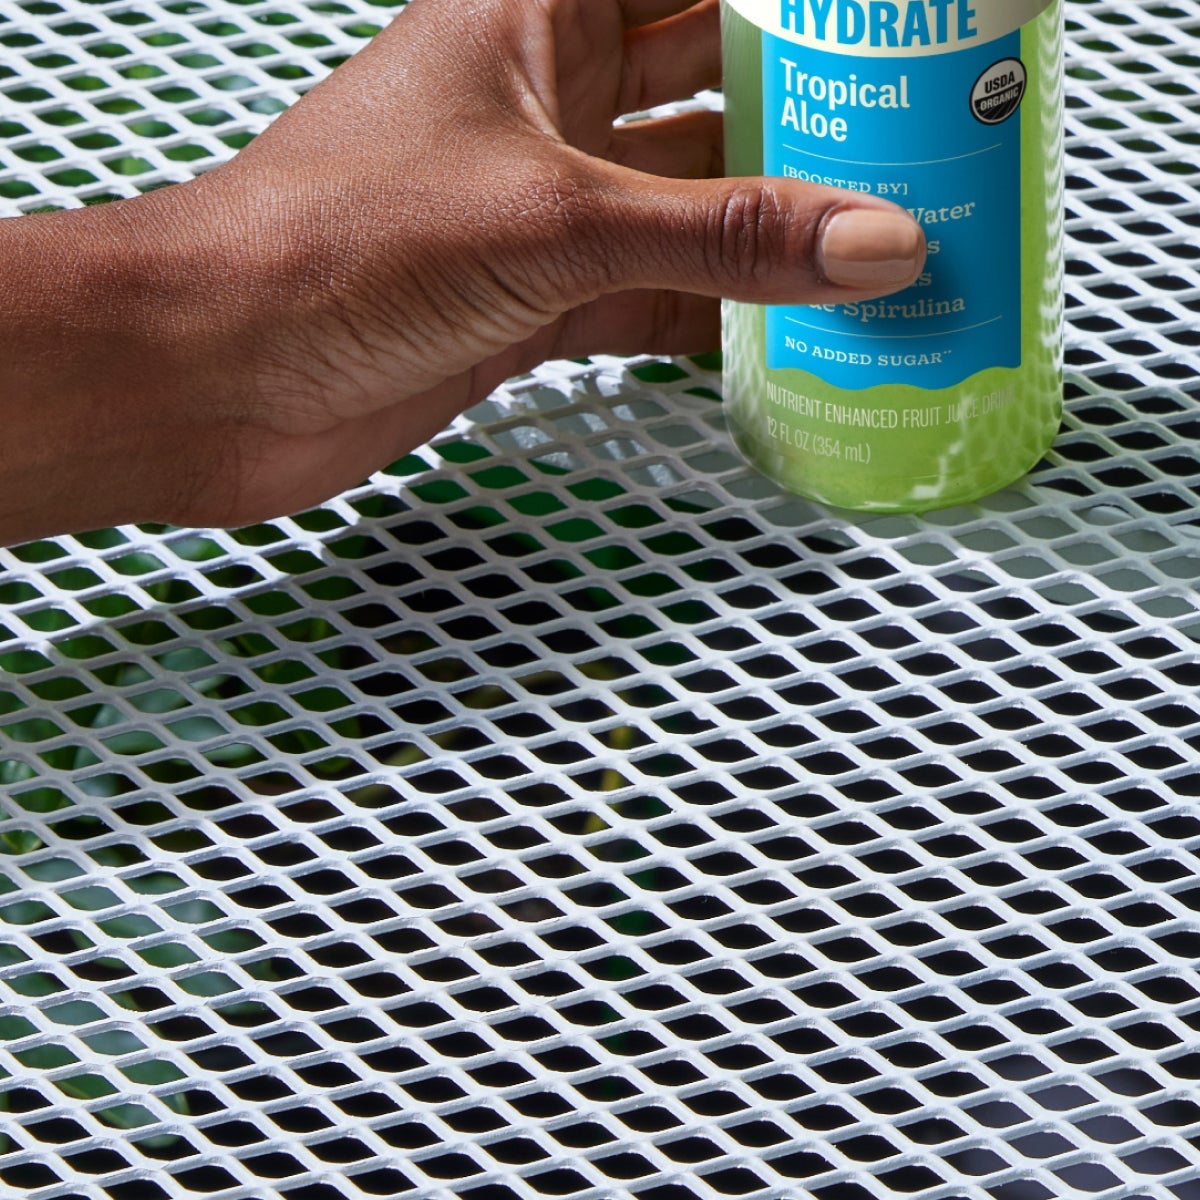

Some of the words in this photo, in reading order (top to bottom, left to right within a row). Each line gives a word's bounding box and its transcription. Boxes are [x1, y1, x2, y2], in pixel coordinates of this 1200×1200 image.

[780, 57, 910, 111] Tropical
[984, 71, 1016, 94] USDA
[980, 86, 1019, 111] ORGANIC
[780, 97, 848, 142] Aloe
[876, 183, 908, 195] BY]
[843, 297, 966, 322] Spirulina
[784, 335, 808, 353] NO
[812, 345, 872, 366] ADDED
[766, 380, 822, 420] NUTRIENT
[825, 402, 898, 429] ENHANCED
[902, 406, 942, 429] FRUIT
[766, 415, 778, 440] 12
[779, 422, 793, 446] FL
[794, 429, 810, 452] OZ
[812, 434, 841, 459] (354
[845, 443, 872, 465] mL)
